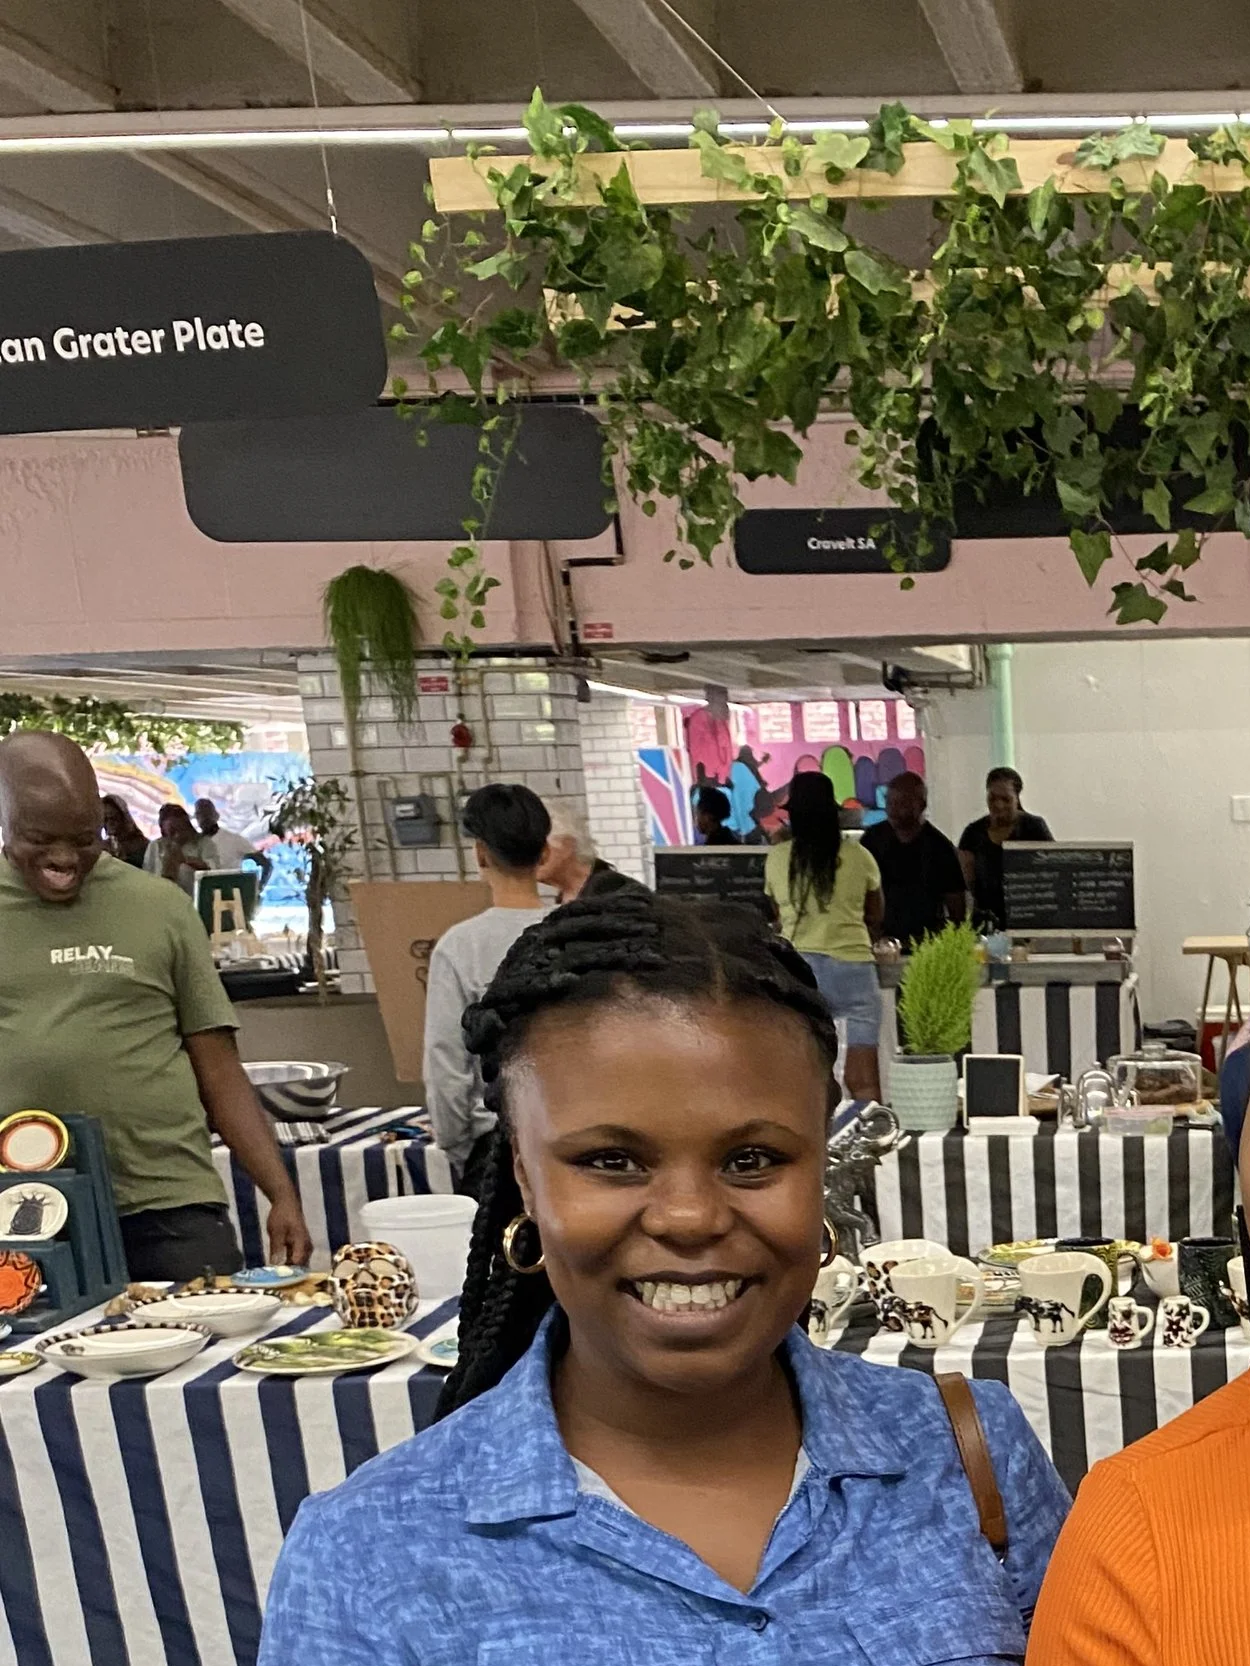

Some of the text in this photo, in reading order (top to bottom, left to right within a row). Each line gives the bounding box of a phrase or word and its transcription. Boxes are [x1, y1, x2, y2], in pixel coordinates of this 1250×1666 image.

[0, 316, 265, 363] an Grater Plate
[857, 537, 876, 550] SA
[50, 945, 113, 965] RELAY
